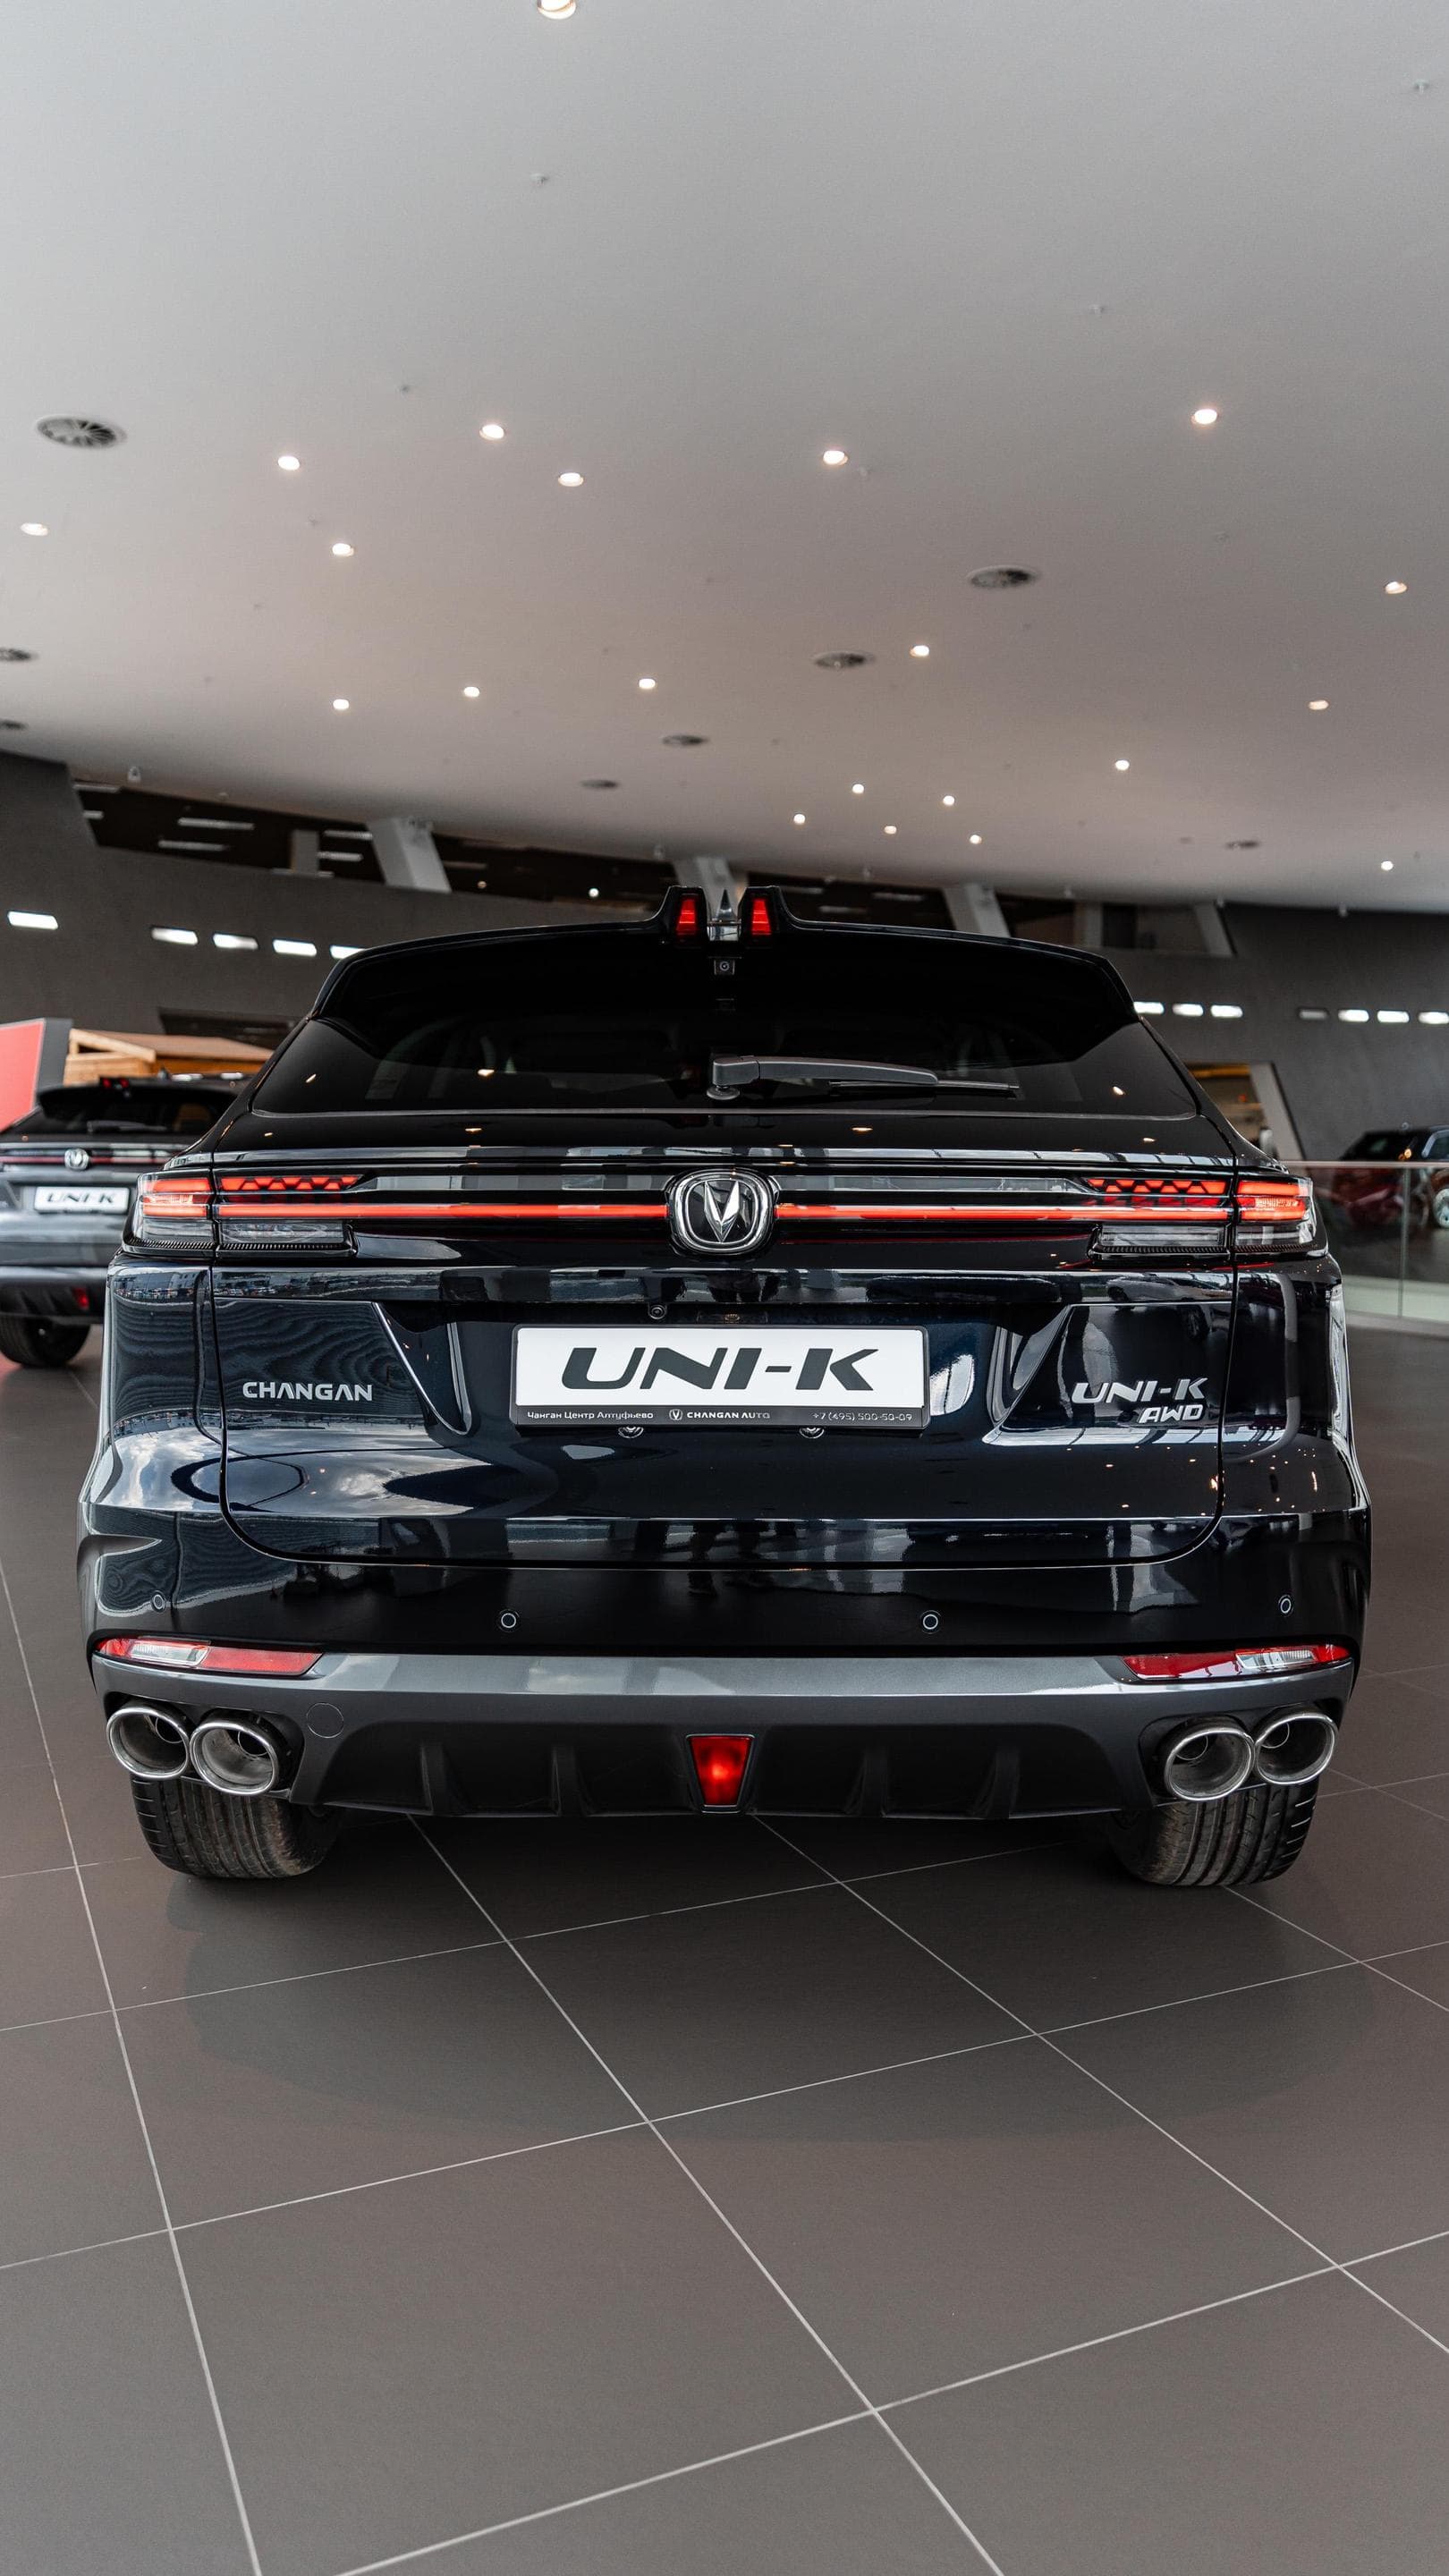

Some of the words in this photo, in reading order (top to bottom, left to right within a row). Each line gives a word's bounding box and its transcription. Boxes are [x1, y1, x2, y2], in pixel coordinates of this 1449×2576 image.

[47, 1192, 115, 1204] UNIK
[561, 1346, 879, 1391] UNI-K
[242, 1381, 373, 1402] CHANGAN
[1072, 1377, 1208, 1403] UNI-K
[527, 1411, 563, 1419] Чанган
[564, 1411, 595, 1420] Центр
[597, 1411, 654, 1420] Алтуфьево
[686, 1411, 740, 1419] CHANGAN
[741, 1411, 771, 1419] AUTO
[812, 1412, 826, 1420] +7
[827, 1411, 855, 1421] (495)
[858, 1412, 912, 1421] 500-50-09
[1139, 1404, 1203, 1423] AWD
